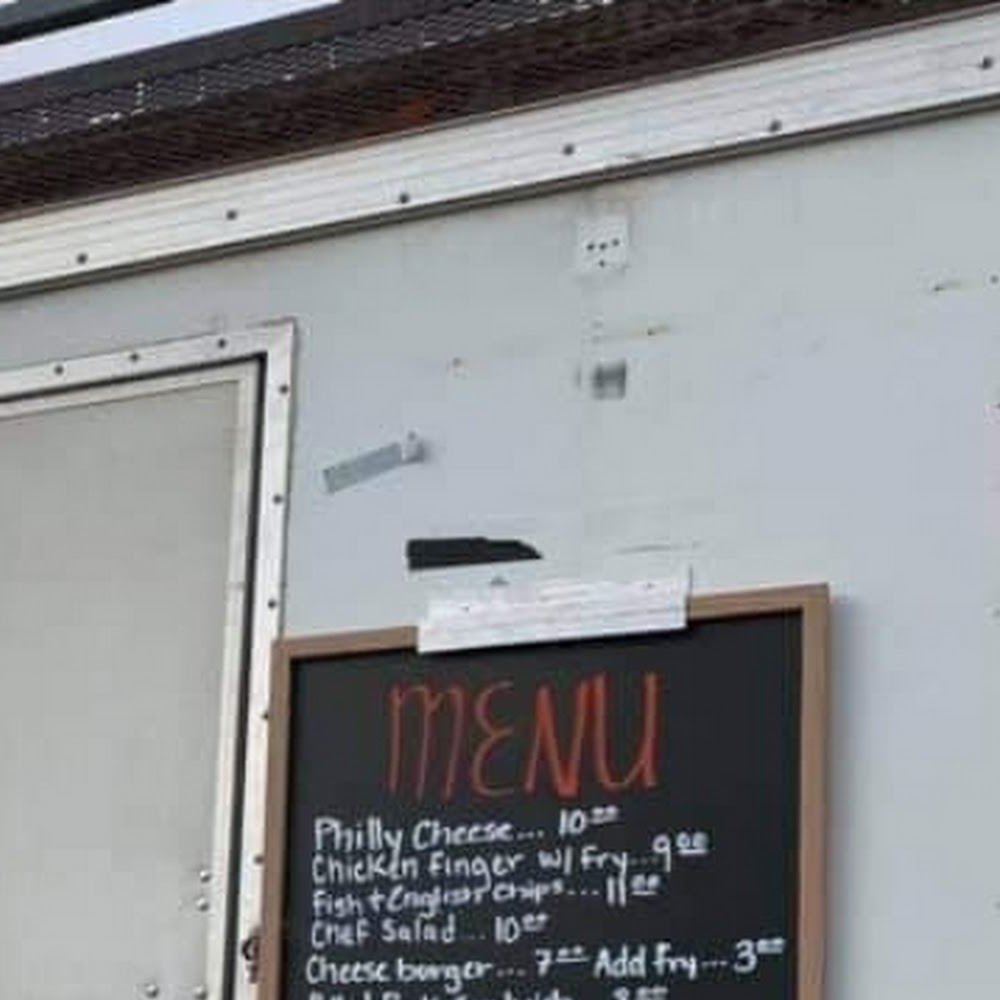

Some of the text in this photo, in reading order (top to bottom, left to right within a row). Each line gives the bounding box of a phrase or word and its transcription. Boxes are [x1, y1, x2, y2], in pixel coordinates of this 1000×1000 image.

[388, 672, 663, 800] MENU
[314, 815, 403, 880] Philly
[429, 849, 524, 894] Finger
[594, 944, 648, 979] Add
